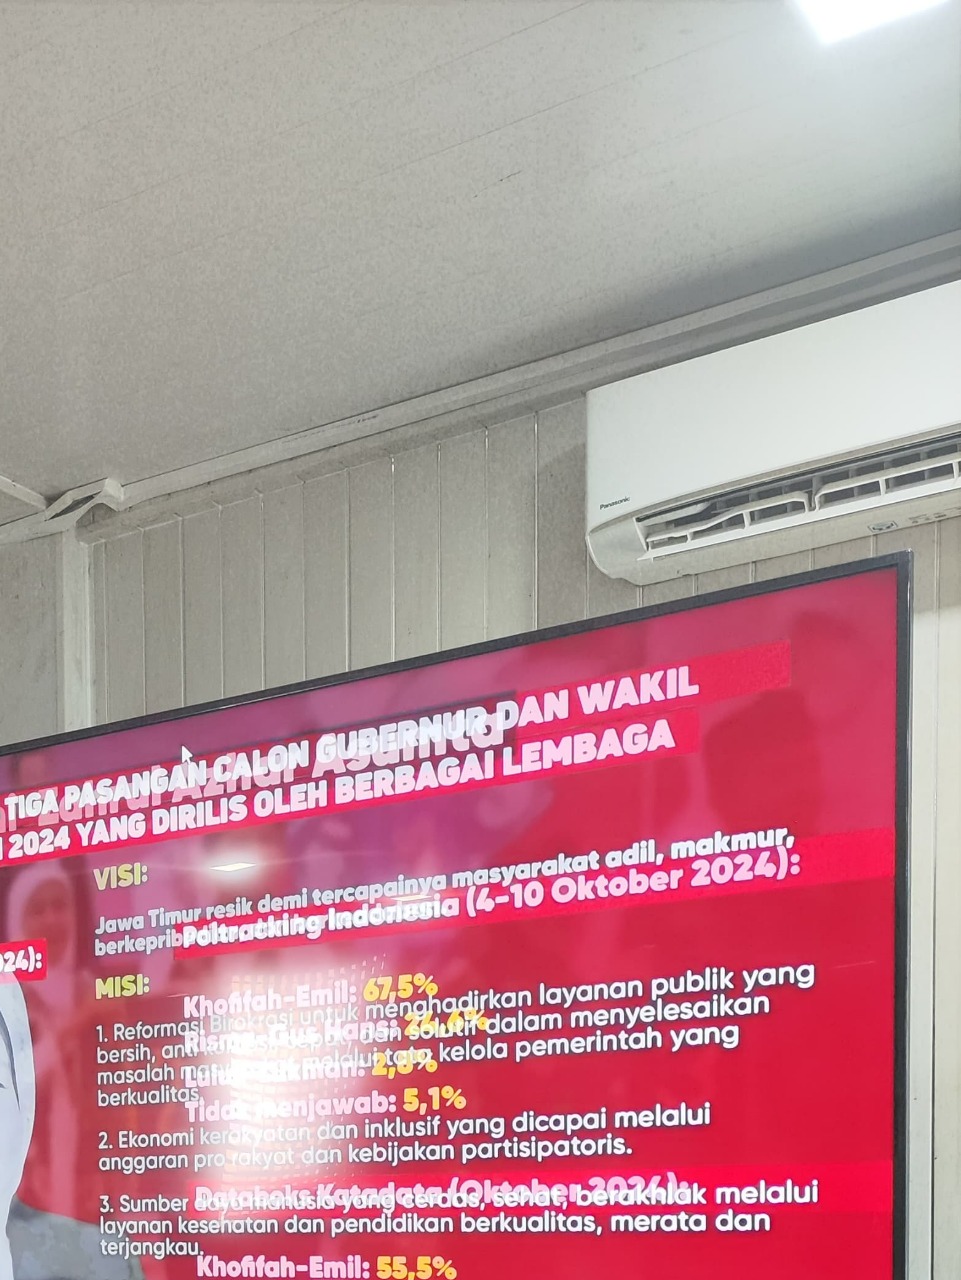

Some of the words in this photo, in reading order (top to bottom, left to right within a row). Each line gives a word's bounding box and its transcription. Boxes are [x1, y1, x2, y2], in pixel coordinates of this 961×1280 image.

[599, 496, 630, 510] Panasonic
[4, 788, 58, 821] TIGA
[63, 759, 207, 810] PASANGAN
[213, 739, 309, 784] CALON
[315, 706, 488, 765] GUBERNUR
[496, 689, 569, 731] DAN
[577, 665, 699, 715] WAKIL
[8, 825, 71, 859] 2024
[75, 812, 146, 847] YANG
[151, 794, 248, 835] DIRILIS
[253, 779, 327, 818] OLEH
[334, 749, 494, 804] BERBAGAI
[503, 718, 676, 776] LEMBAGA
[93, 862, 148, 891] VISI:
[95, 915, 144, 935] Jawa
[148, 907, 201, 928] Timur
[206, 896, 253, 920] resik
[257, 887, 308, 914] demi
[312, 874, 447, 912] tercapainya
[452, 850, 600, 893] masyarakat
[604, 838, 664, 871] adil,
[670, 827, 795, 862] makmur,
[466, 876, 545, 918] (4-10
[551, 862, 682, 904] Oktober
[690, 844, 800, 887] 2024):
[95, 973, 150, 1000] MISI:
[183, 979, 356, 1019] Khofifah-Emil:
[362, 972, 439, 1006] 67,5%
[364, 988, 531, 1024] menghadirkan
[539, 979, 643, 1009] layanan
[651, 966, 734, 1002] publik
[743, 964, 815, 993] yang
[96, 1043, 156, 1064] bersih,
[486, 1009, 562, 1035] dalam
[570, 993, 769, 1033] menyelesaikan
[97, 1063, 174, 1085] masalah
[439, 1037, 508, 1062] kelola
[515, 1026, 662, 1062] pemerintah
[671, 1025, 739, 1052] yang
[402, 1085, 466, 1115] 5,1%
[98, 1131, 112, 1150] 2.
[118, 1127, 194, 1149] Ekonomi
[364, 1115, 440, 1139] inklusif
[446, 1117, 505, 1140] yang
[511, 1107, 607, 1137] dicapai
[614, 1101, 711, 1129] melalui
[98, 1154, 187, 1175] anggaran
[194, 1152, 225, 1172] pro
[301, 1144, 341, 1164] dan
[348, 1140, 455, 1167] kebijakan
[461, 1132, 632, 1164] partisipatoris.
[119, 1194, 189, 1213] Sumber
[715, 1178, 818, 1204] melalui
[100, 1216, 172, 1236] layanan
[178, 1215, 278, 1234] kesehatan
[284, 1215, 324, 1233] dan
[330, 1212, 453, 1237] pendidikan
[460, 1210, 602, 1236] berkualitas,
[610, 1211, 706, 1232] merata
[715, 1208, 769, 1232] dan
[100, 1237, 204, 1260] terjangkau.
[196, 1254, 370, 1279] Khofifah-Emil:
